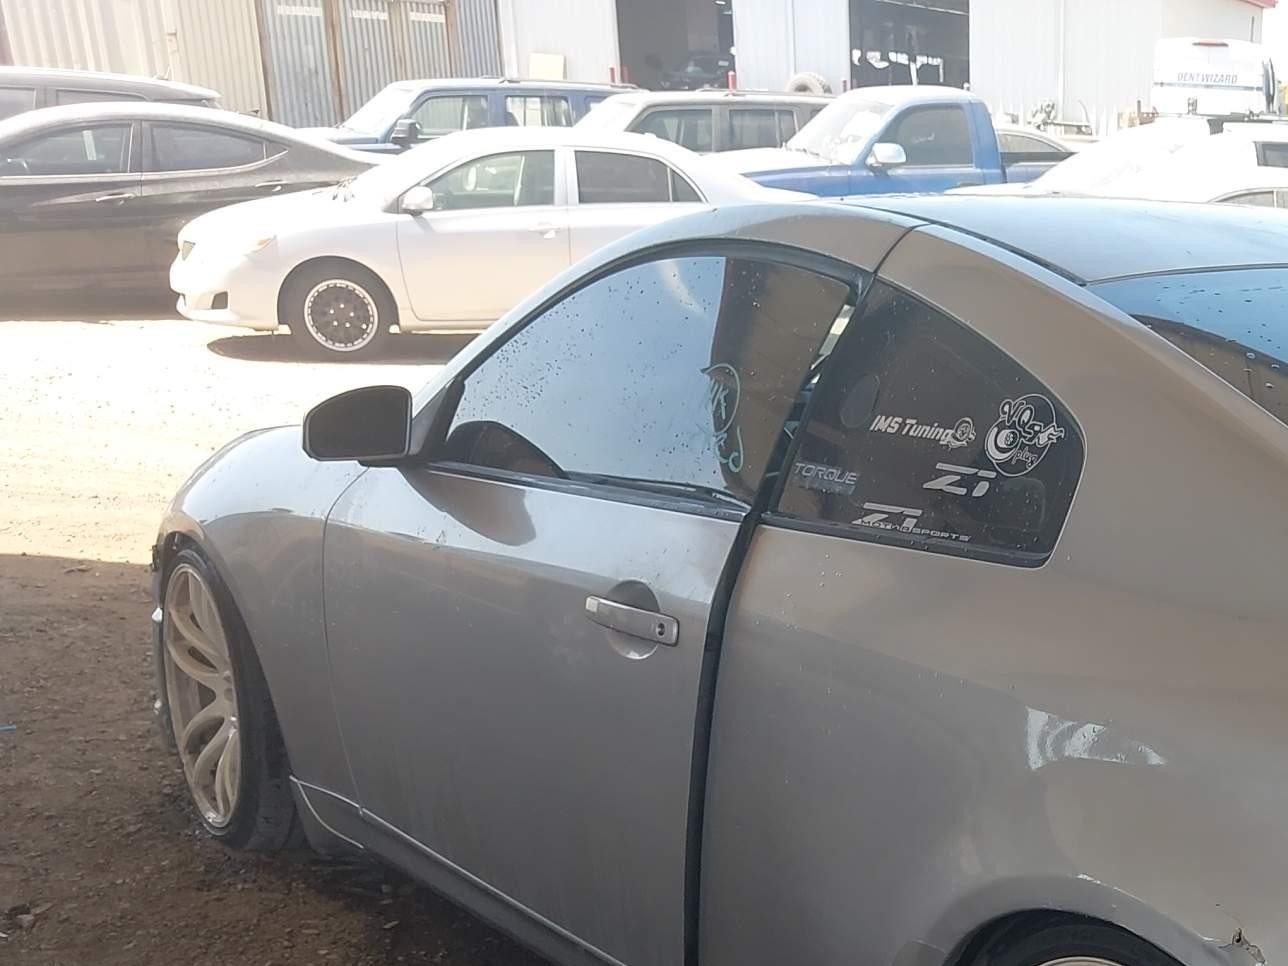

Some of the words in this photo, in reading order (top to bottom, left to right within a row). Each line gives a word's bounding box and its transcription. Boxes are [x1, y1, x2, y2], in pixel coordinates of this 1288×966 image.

[1178, 72, 1200, 82] DENT
[1201, 73, 1238, 84] WIZARD
[869, 415, 903, 433] IMS
[901, 418, 954, 445] Tuning
[794, 462, 857, 485] TORQUE
